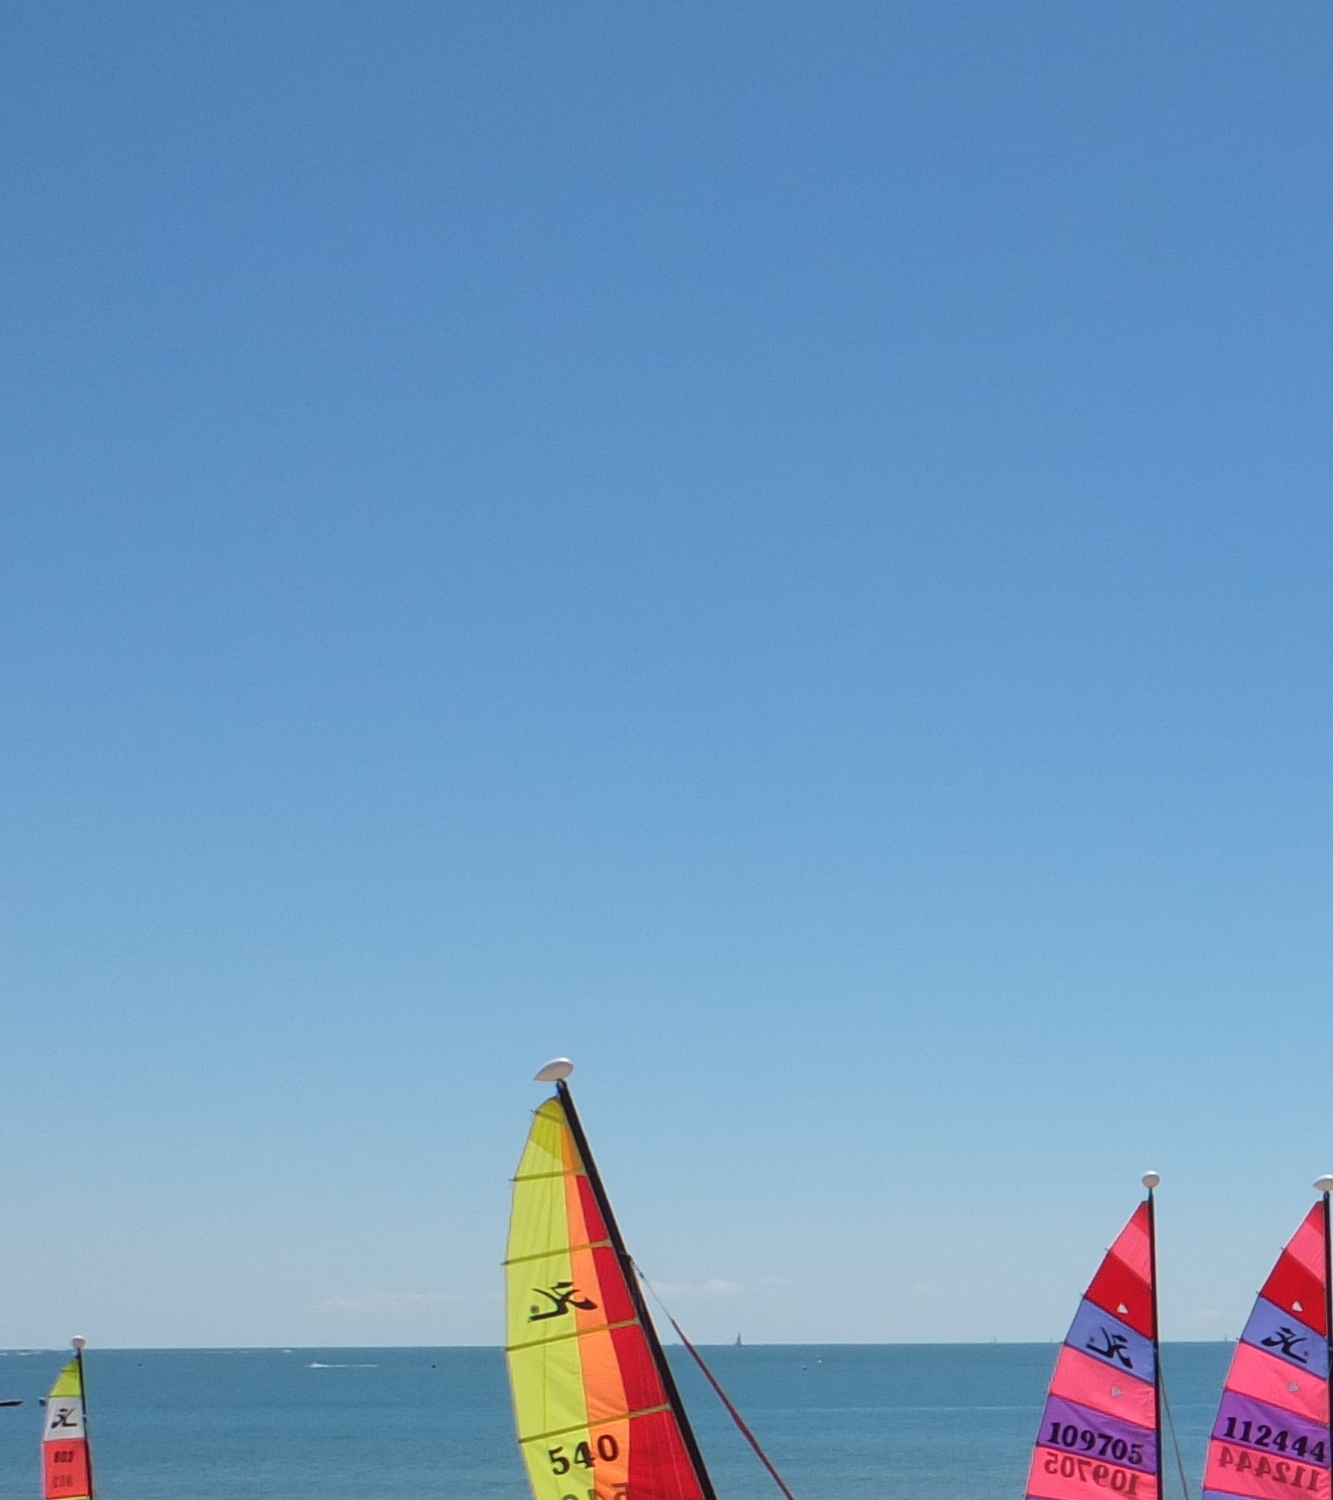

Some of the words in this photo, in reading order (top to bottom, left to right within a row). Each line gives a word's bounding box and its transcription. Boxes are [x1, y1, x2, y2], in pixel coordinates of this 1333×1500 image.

[548, 1434, 620, 1475] 540
[1047, 1422, 1144, 1465] 109705
[1223, 1416, 1326, 1462] 112444
